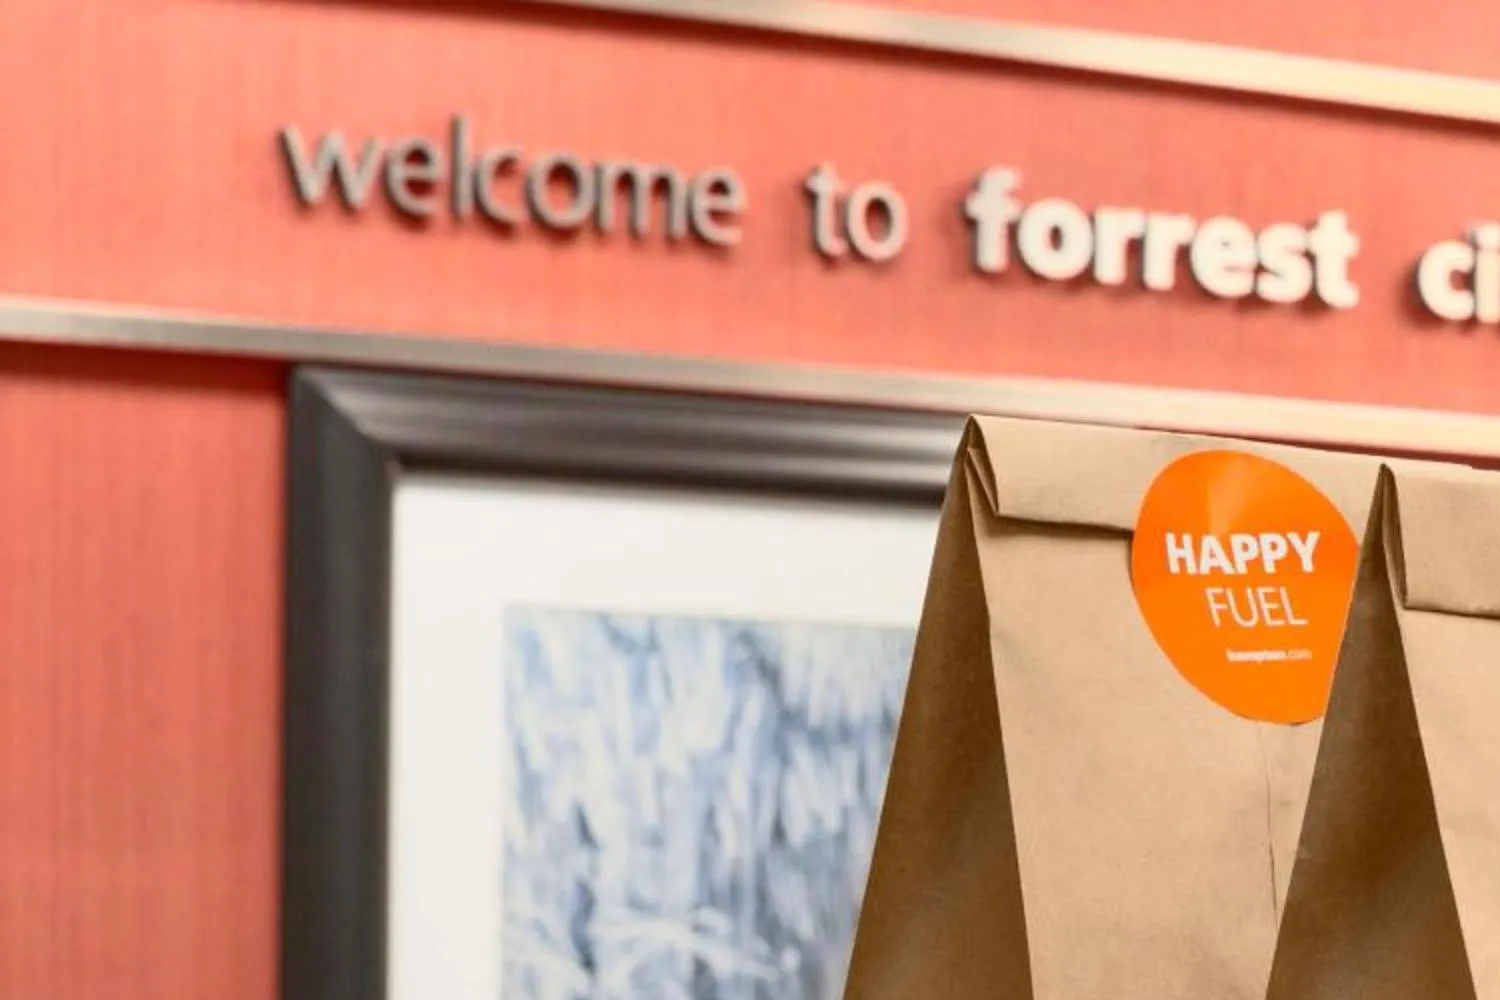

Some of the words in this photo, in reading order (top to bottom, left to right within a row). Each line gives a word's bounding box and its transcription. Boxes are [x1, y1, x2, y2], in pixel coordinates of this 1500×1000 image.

[281, 115, 746, 247] welcome
[806, 161, 908, 262] to
[965, 166, 1360, 309] forrest
[1164, 530, 1320, 575] HAPPY
[1204, 586, 1309, 628] FUEL
